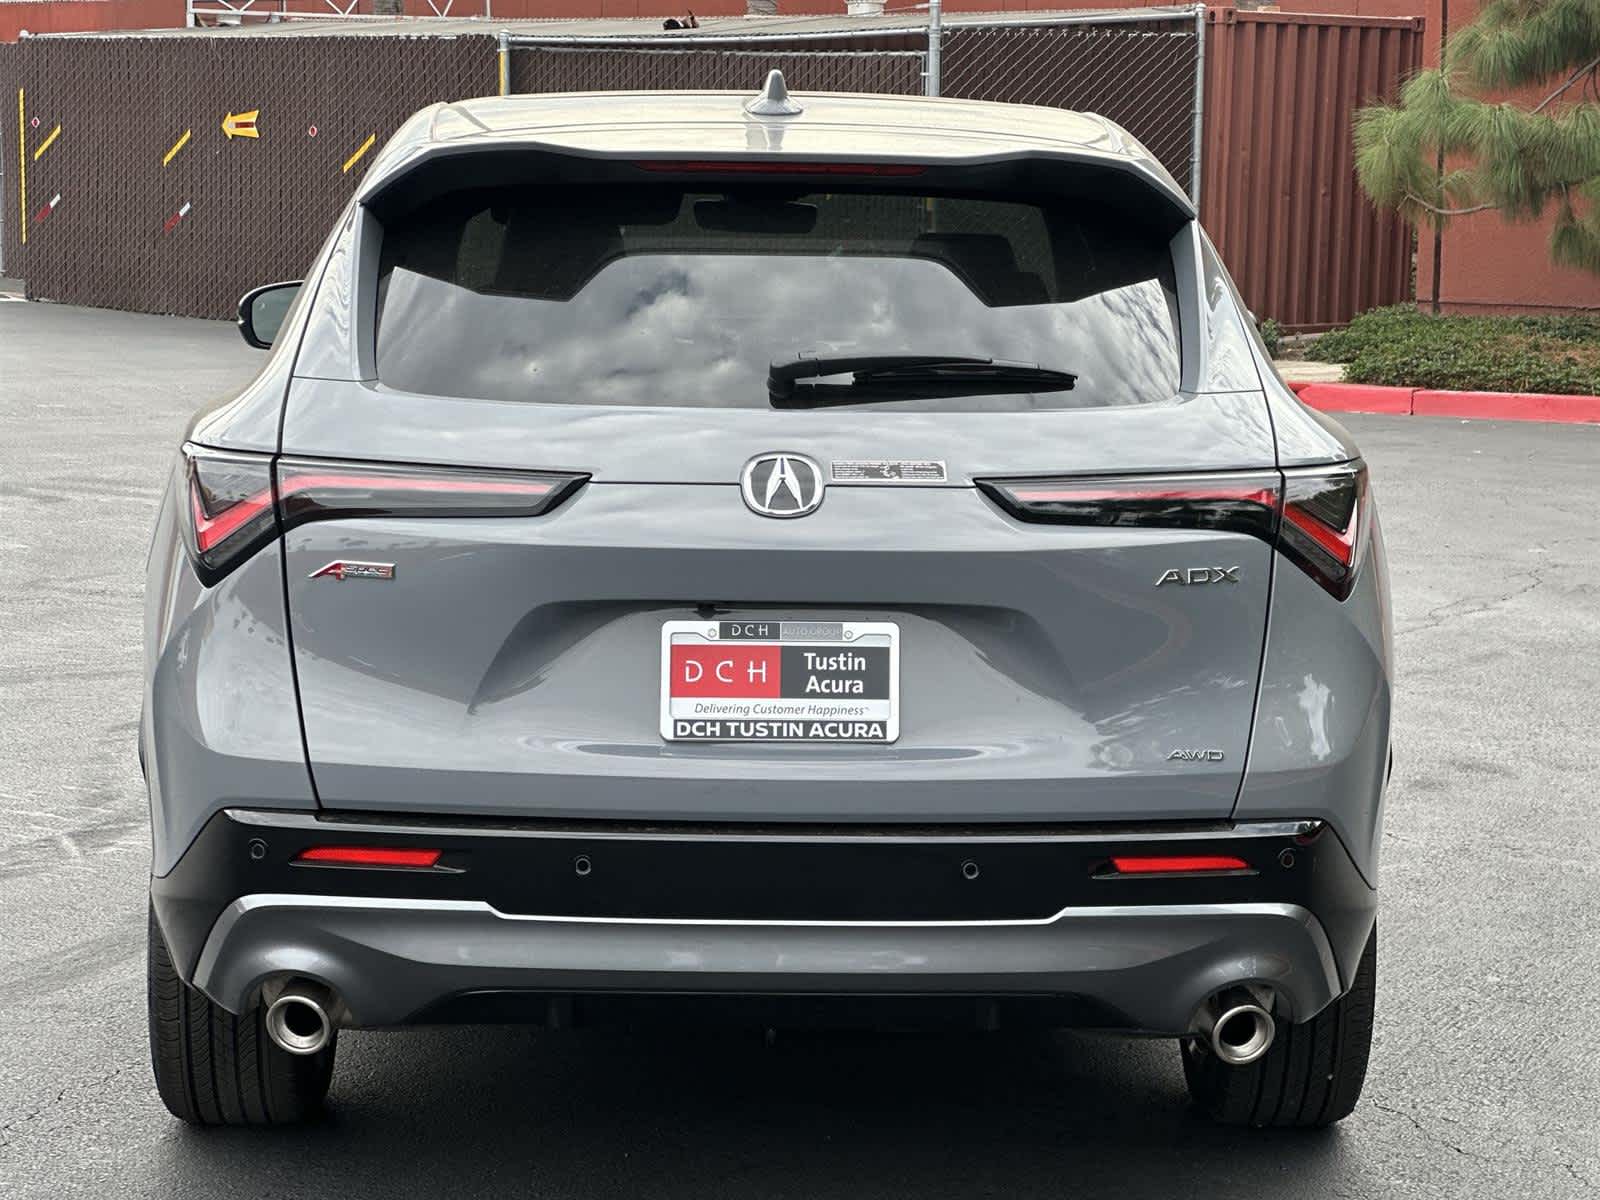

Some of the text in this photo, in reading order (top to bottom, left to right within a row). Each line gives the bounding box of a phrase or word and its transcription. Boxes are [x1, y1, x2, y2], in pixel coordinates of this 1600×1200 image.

[1155, 565, 1240, 586] ADX
[731, 624, 768, 636] DCH
[803, 652, 866, 671] Tustin
[684, 659, 767, 683] DCH
[805, 675, 864, 694] Acura
[694, 702, 751, 715] Delivering
[752, 704, 805, 715] Customer
[676, 722, 883, 738] DCH TUSTIN ACURA
[1166, 749, 1225, 762] AWD
